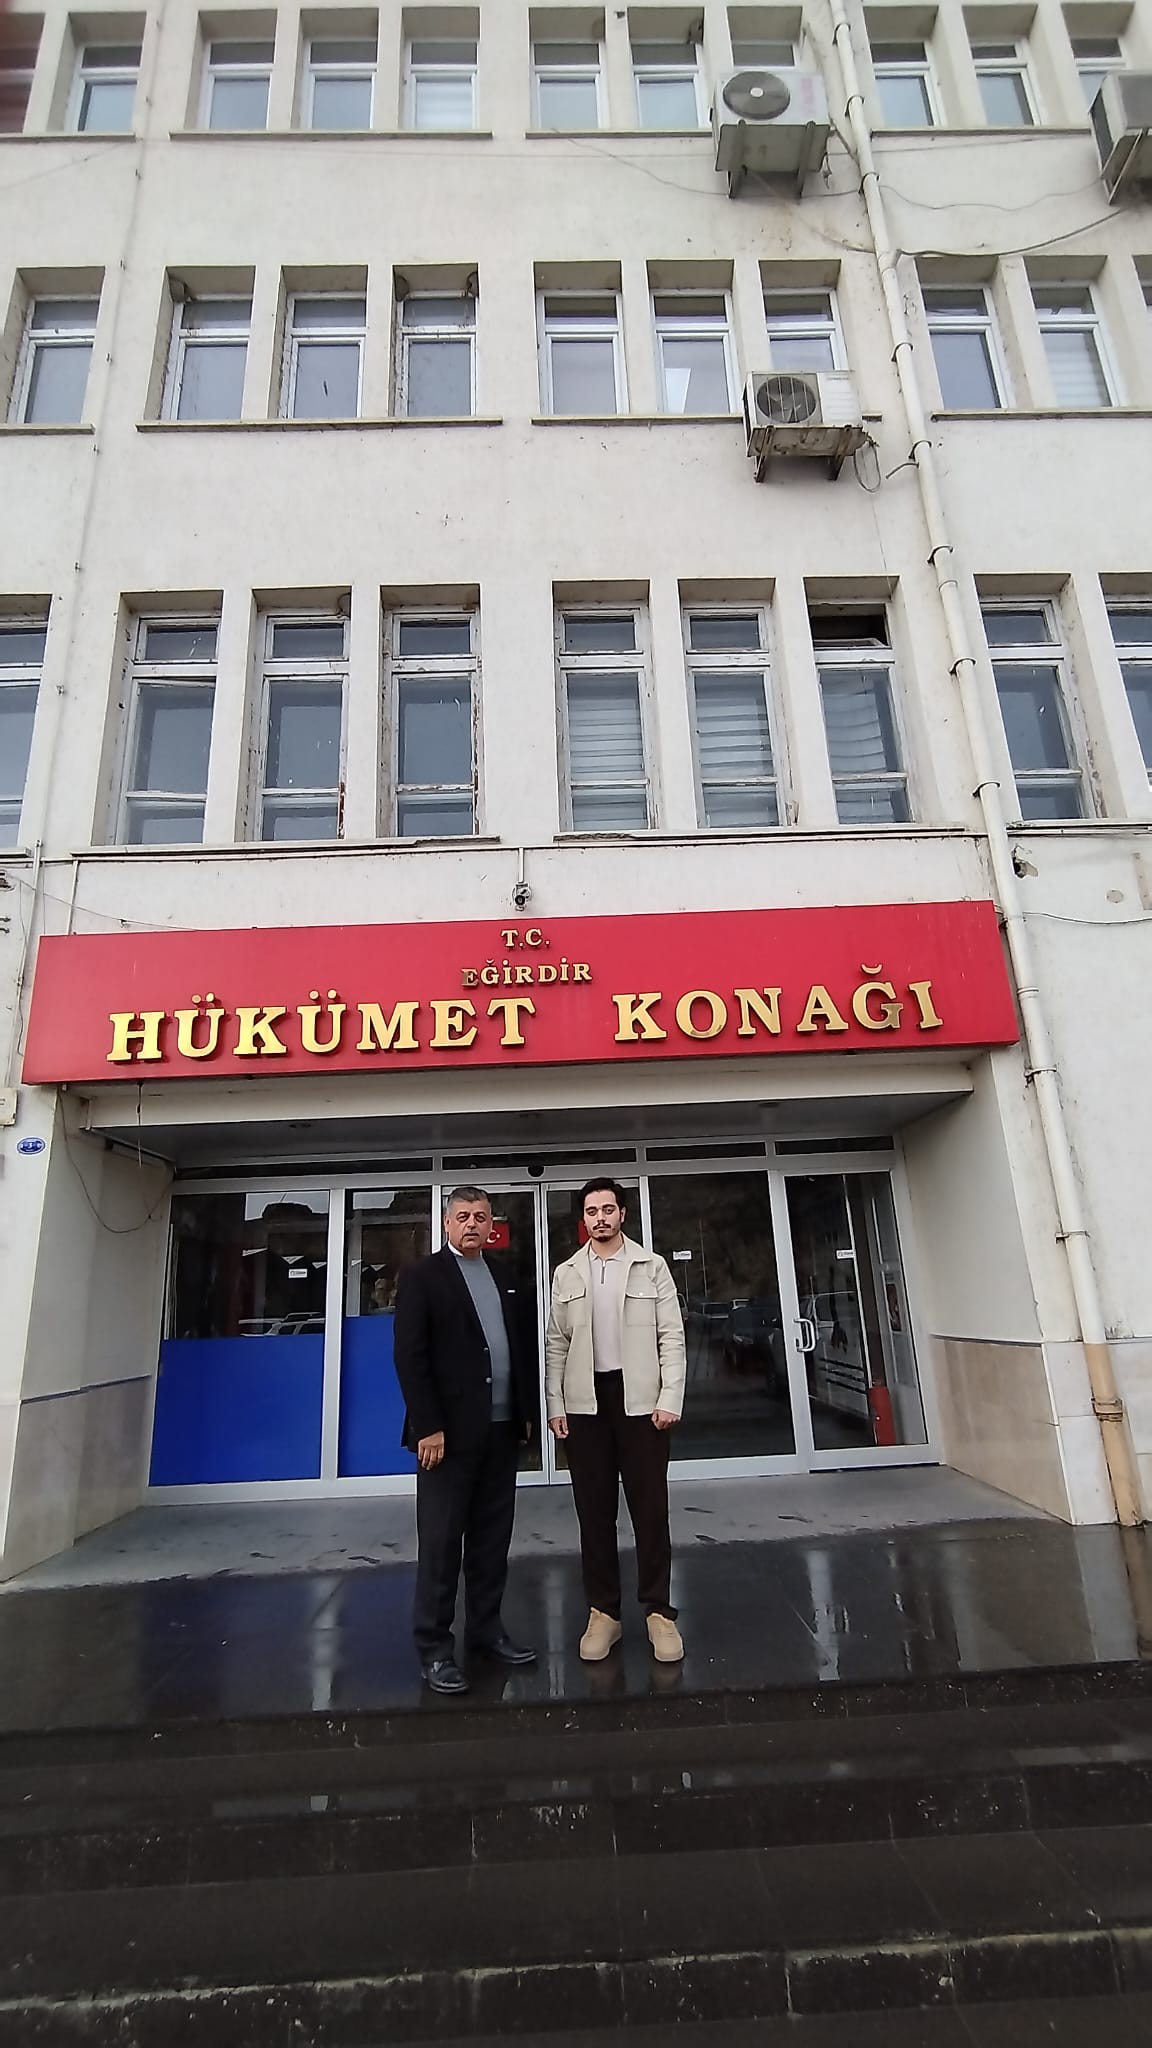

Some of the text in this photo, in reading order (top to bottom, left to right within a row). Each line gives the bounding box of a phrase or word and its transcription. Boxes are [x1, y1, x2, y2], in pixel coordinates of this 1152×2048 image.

[501, 928, 550, 947] T.C.
[461, 957, 593, 987] EĞİRDİR
[107, 963, 943, 1062] HÜKÜMET KONAĞI
